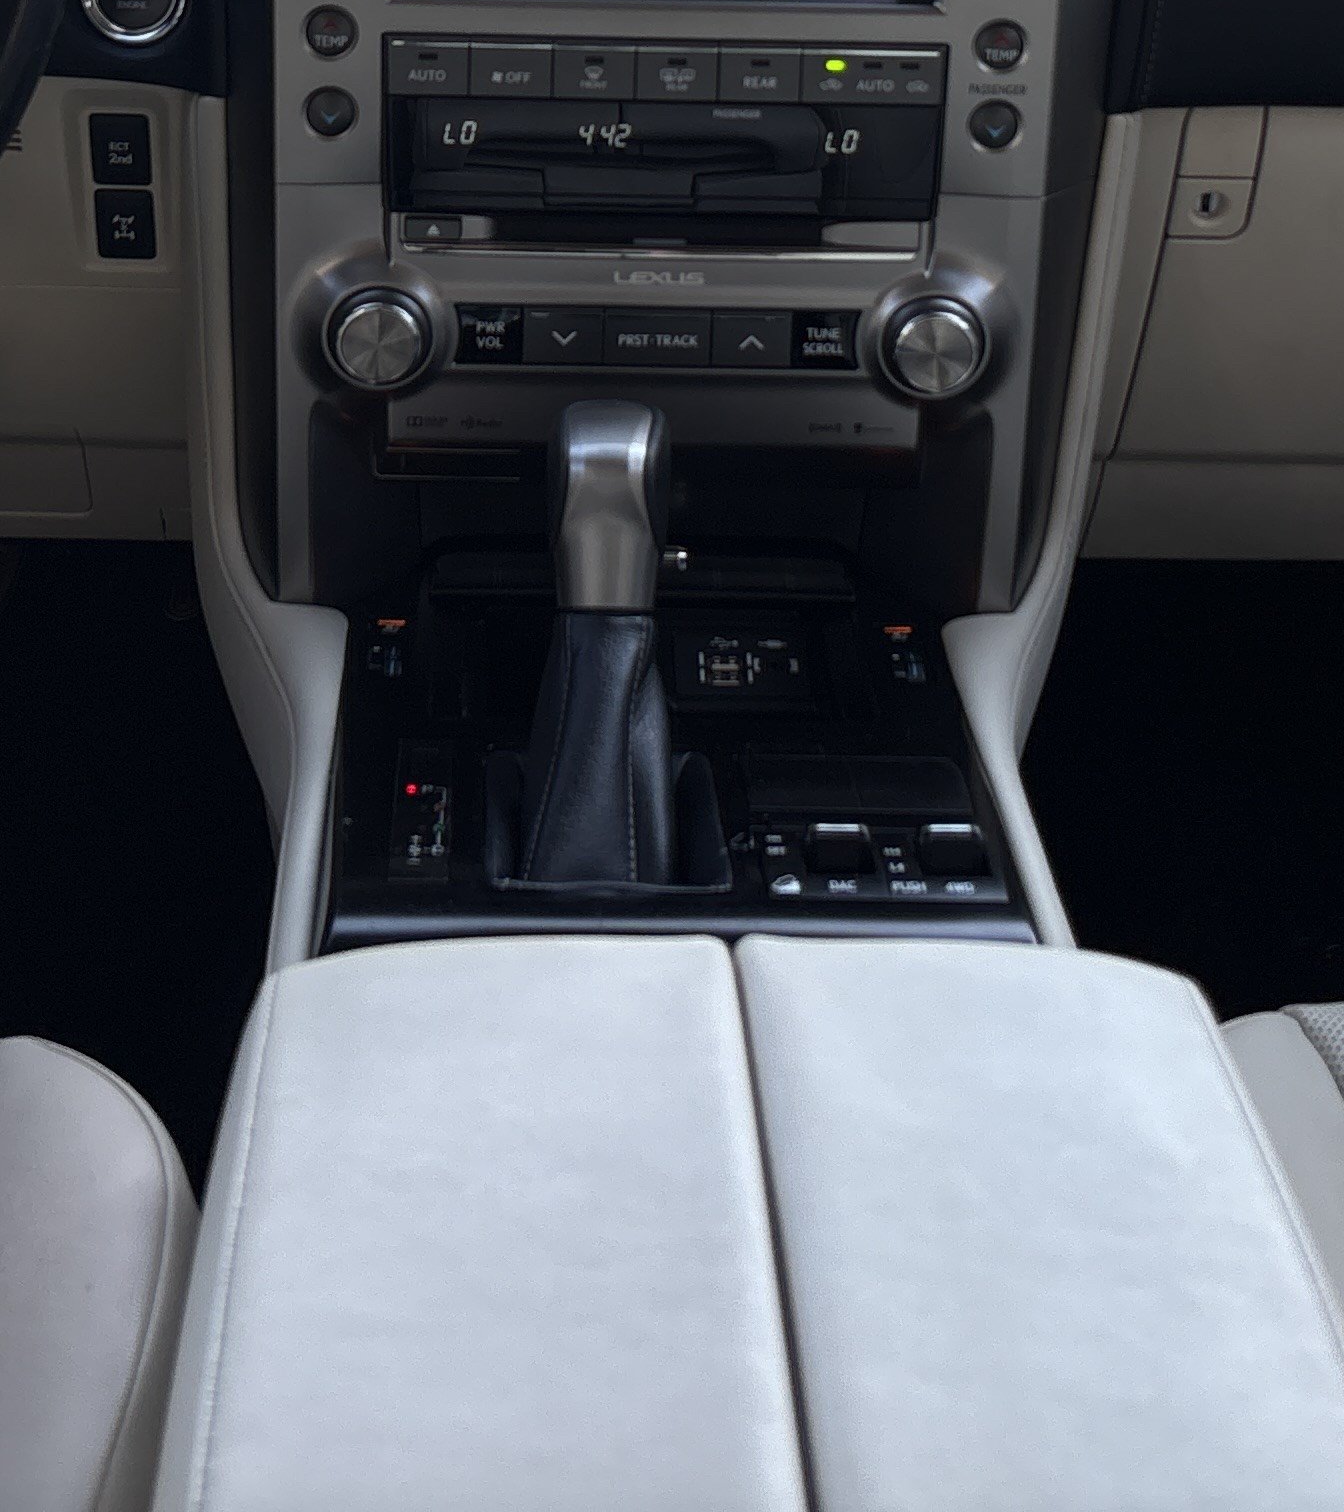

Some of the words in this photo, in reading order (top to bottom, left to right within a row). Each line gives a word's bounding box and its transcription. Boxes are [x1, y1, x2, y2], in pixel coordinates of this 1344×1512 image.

[314, 35, 348, 47] TEMP
[984, 48, 1018, 61] TEMP
[408, 69, 447, 82] AUTO
[505, 71, 532, 84] OFF
[742, 76, 777, 89] REAR
[856, 79, 895, 93] AUTO
[968, 84, 1027, 95] PASSENGER
[109, 153, 133, 164] 2nd
[613, 271, 705, 285] LEXUS
[476, 321, 505, 334] PWR
[806, 327, 840, 340] TUNE
[476, 336, 504, 349] VOL
[618, 334, 649, 347] PRST
[656, 334, 698, 348] TRACK
[803, 342, 843, 355] SCROLL
[827, 879, 858, 894] DAC
[890, 880, 927, 895] PUSH
[945, 881, 976, 895] 4WD
